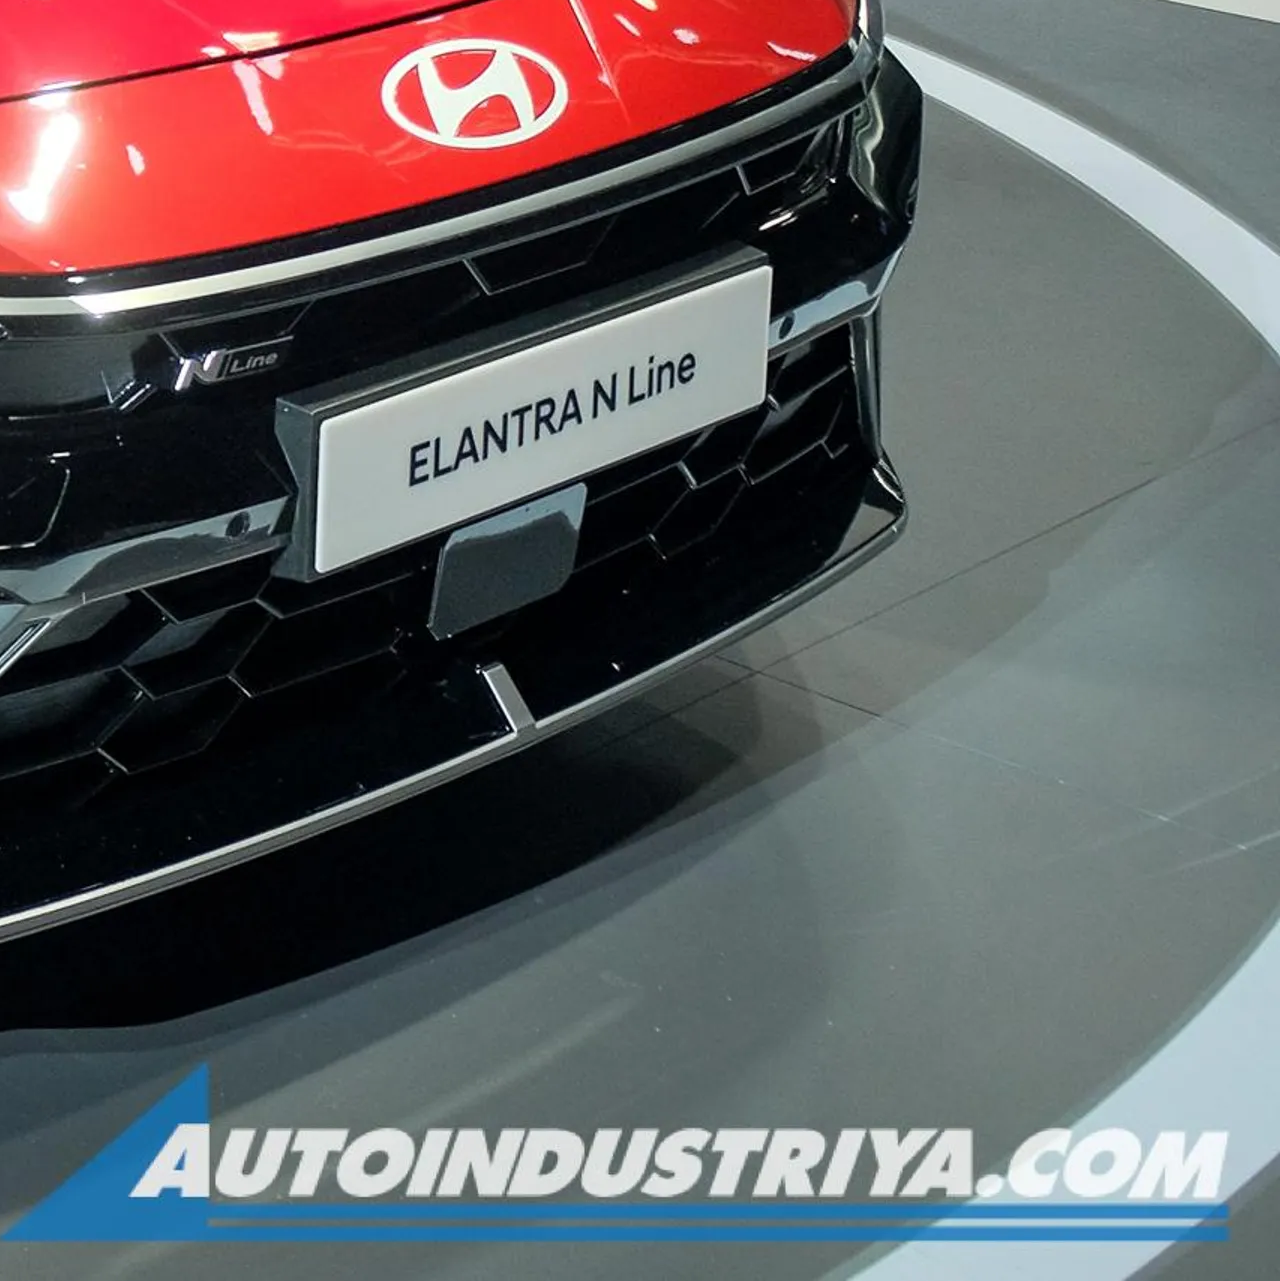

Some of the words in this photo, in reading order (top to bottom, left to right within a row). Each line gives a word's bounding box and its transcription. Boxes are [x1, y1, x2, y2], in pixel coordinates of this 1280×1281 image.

[230, 352, 278, 373] Line
[408, 389, 583, 488] ELANTRA
[591, 373, 619, 420] N
[628, 348, 697, 404] Line
